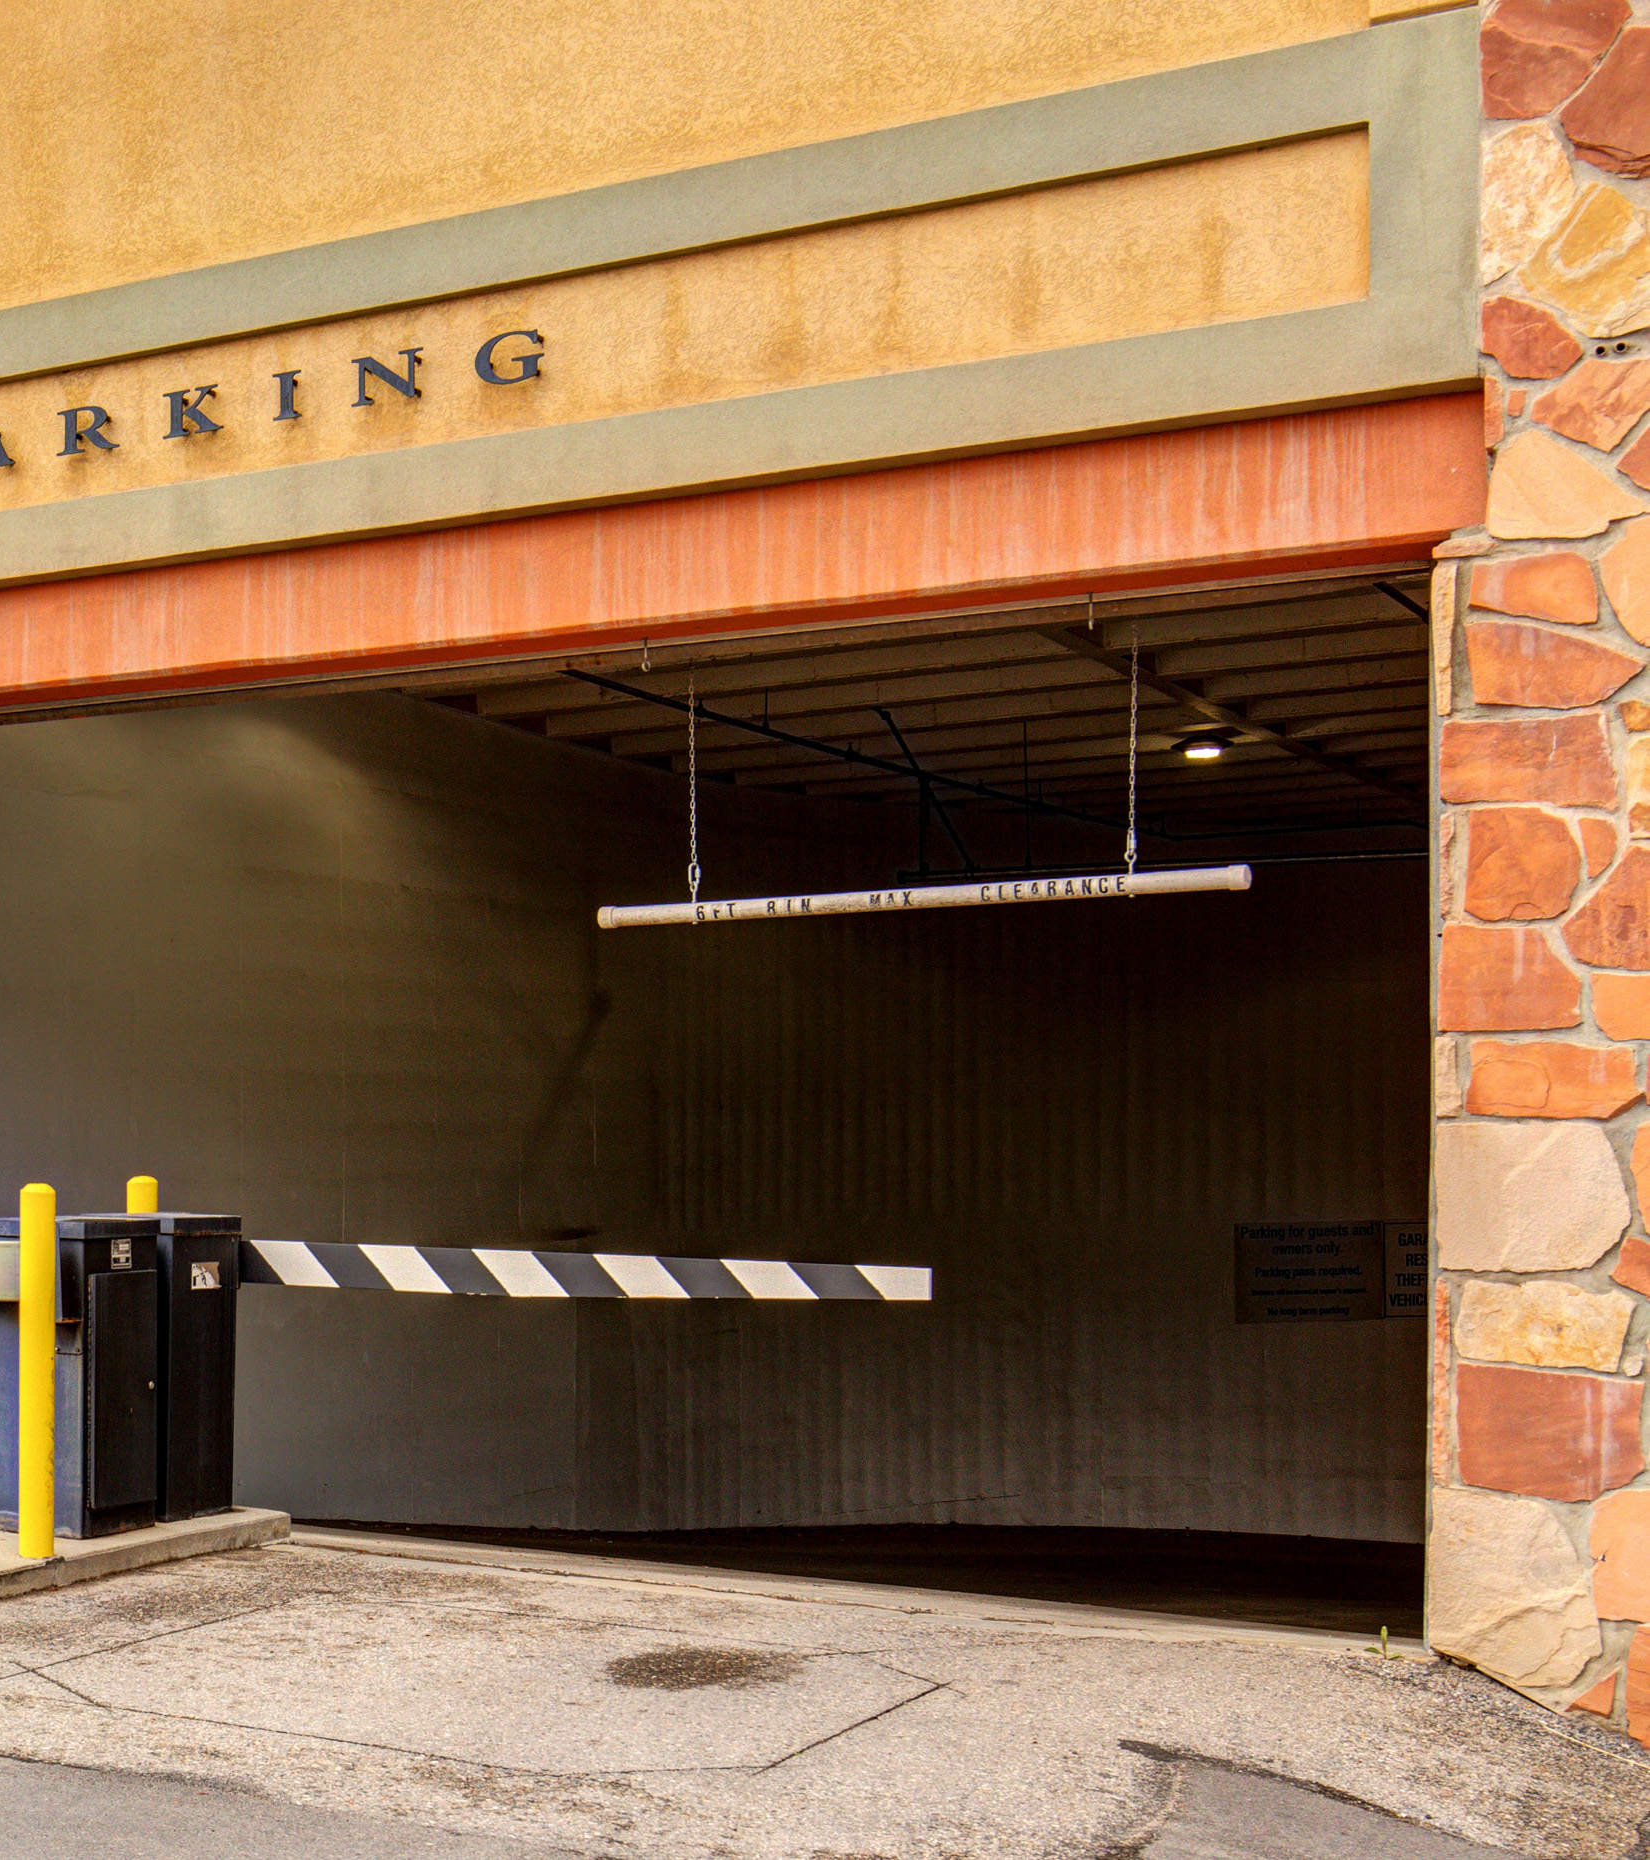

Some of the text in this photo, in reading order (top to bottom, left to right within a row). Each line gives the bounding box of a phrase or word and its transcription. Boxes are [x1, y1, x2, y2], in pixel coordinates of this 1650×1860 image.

[869, 890, 914, 908] MAX
[980, 876, 1126, 904] CLEARANCE
[1240, 1223, 1374, 1241] Parking for guests and
[1272, 1241, 1343, 1257] owners only.
[1254, 1266, 1291, 1279] Parking
[1293, 1267, 1316, 1279] pass
